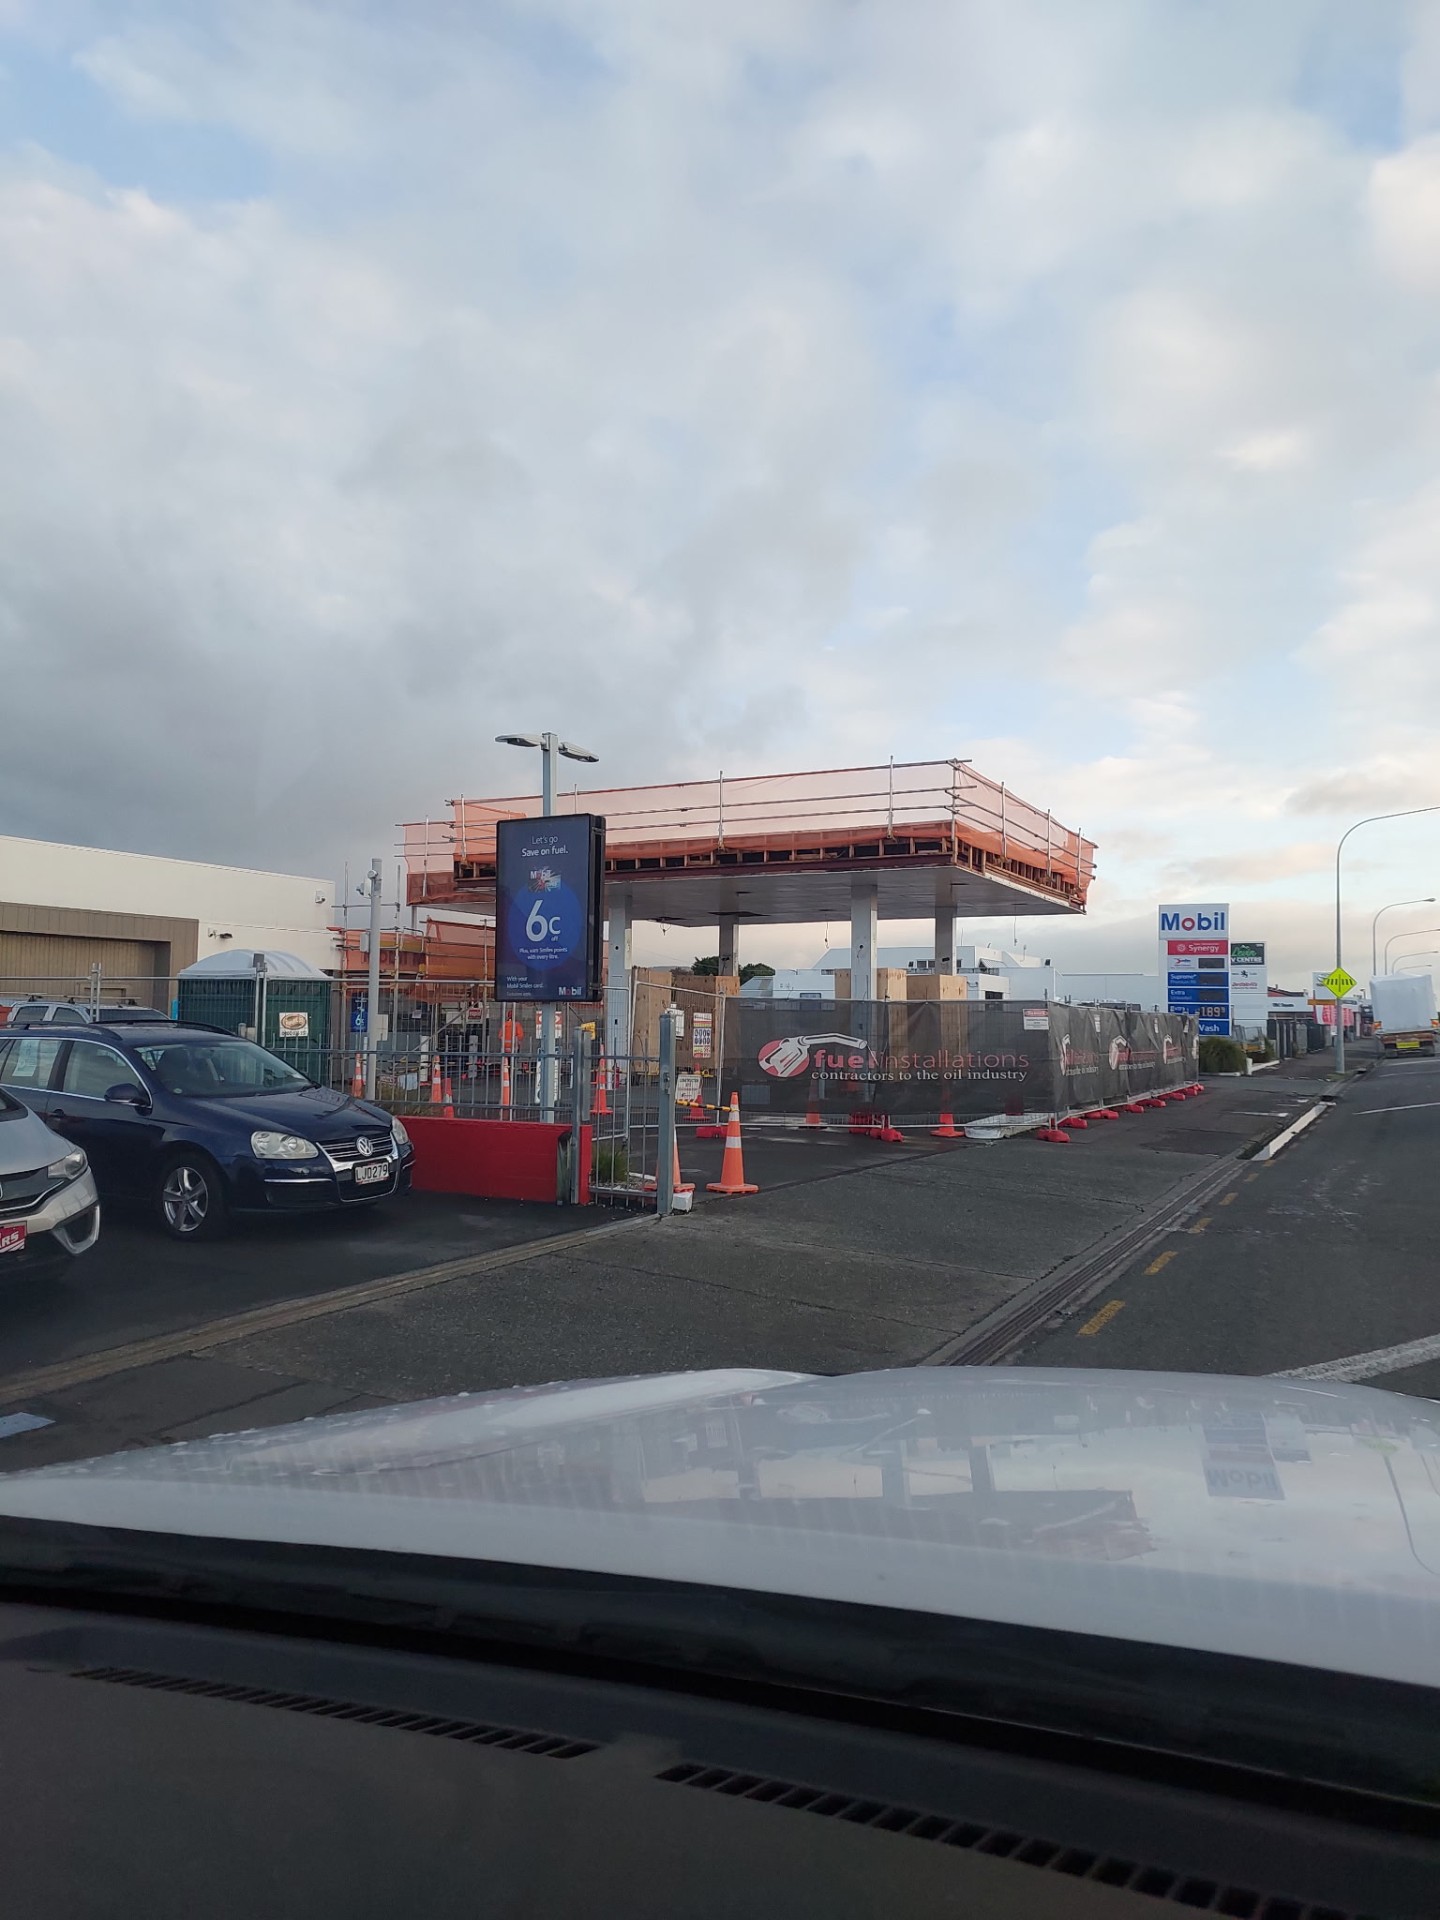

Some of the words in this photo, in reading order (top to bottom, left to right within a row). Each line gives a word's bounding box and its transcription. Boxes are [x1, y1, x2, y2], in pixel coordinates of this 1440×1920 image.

[532, 836, 548, 844] Let's
[549, 836, 559, 845] go
[522, 848, 539, 857] Save
[552, 845, 568, 854] fuel.
[1161, 912, 1225, 931] Mobil
[558, 986, 582, 996] Mobil
[811, 1070, 894, 1081] contractors
[898, 1070, 912, 1081] to
[917, 1070, 938, 1080] the
[944, 1069, 962, 1080] oil
[968, 1069, 1027, 1082] industry
[0, 1230, 19, 1248] RS
